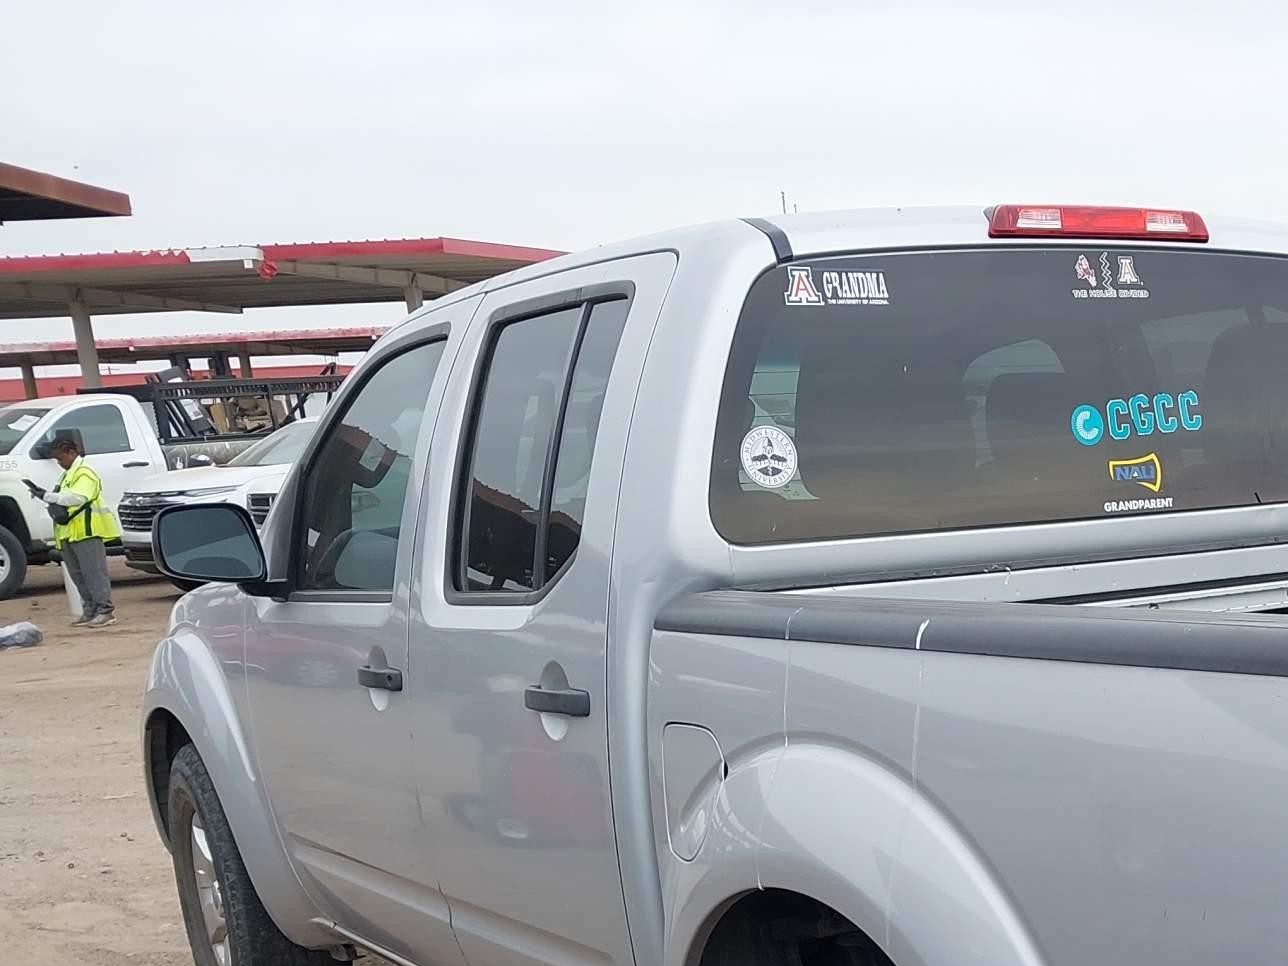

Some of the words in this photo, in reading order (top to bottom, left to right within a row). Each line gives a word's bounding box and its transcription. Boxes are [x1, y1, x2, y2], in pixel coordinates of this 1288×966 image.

[822, 271, 889, 299] GRANDMA
[1072, 289, 1088, 298] THE
[1106, 390, 1202, 440] CGCC
[743, 428, 794, 456] MIDWESTERN
[747, 463, 793, 484] UNIVERSITY
[1114, 464, 1156, 481] NAU
[1103, 497, 1173, 512] GRANDPARENT
